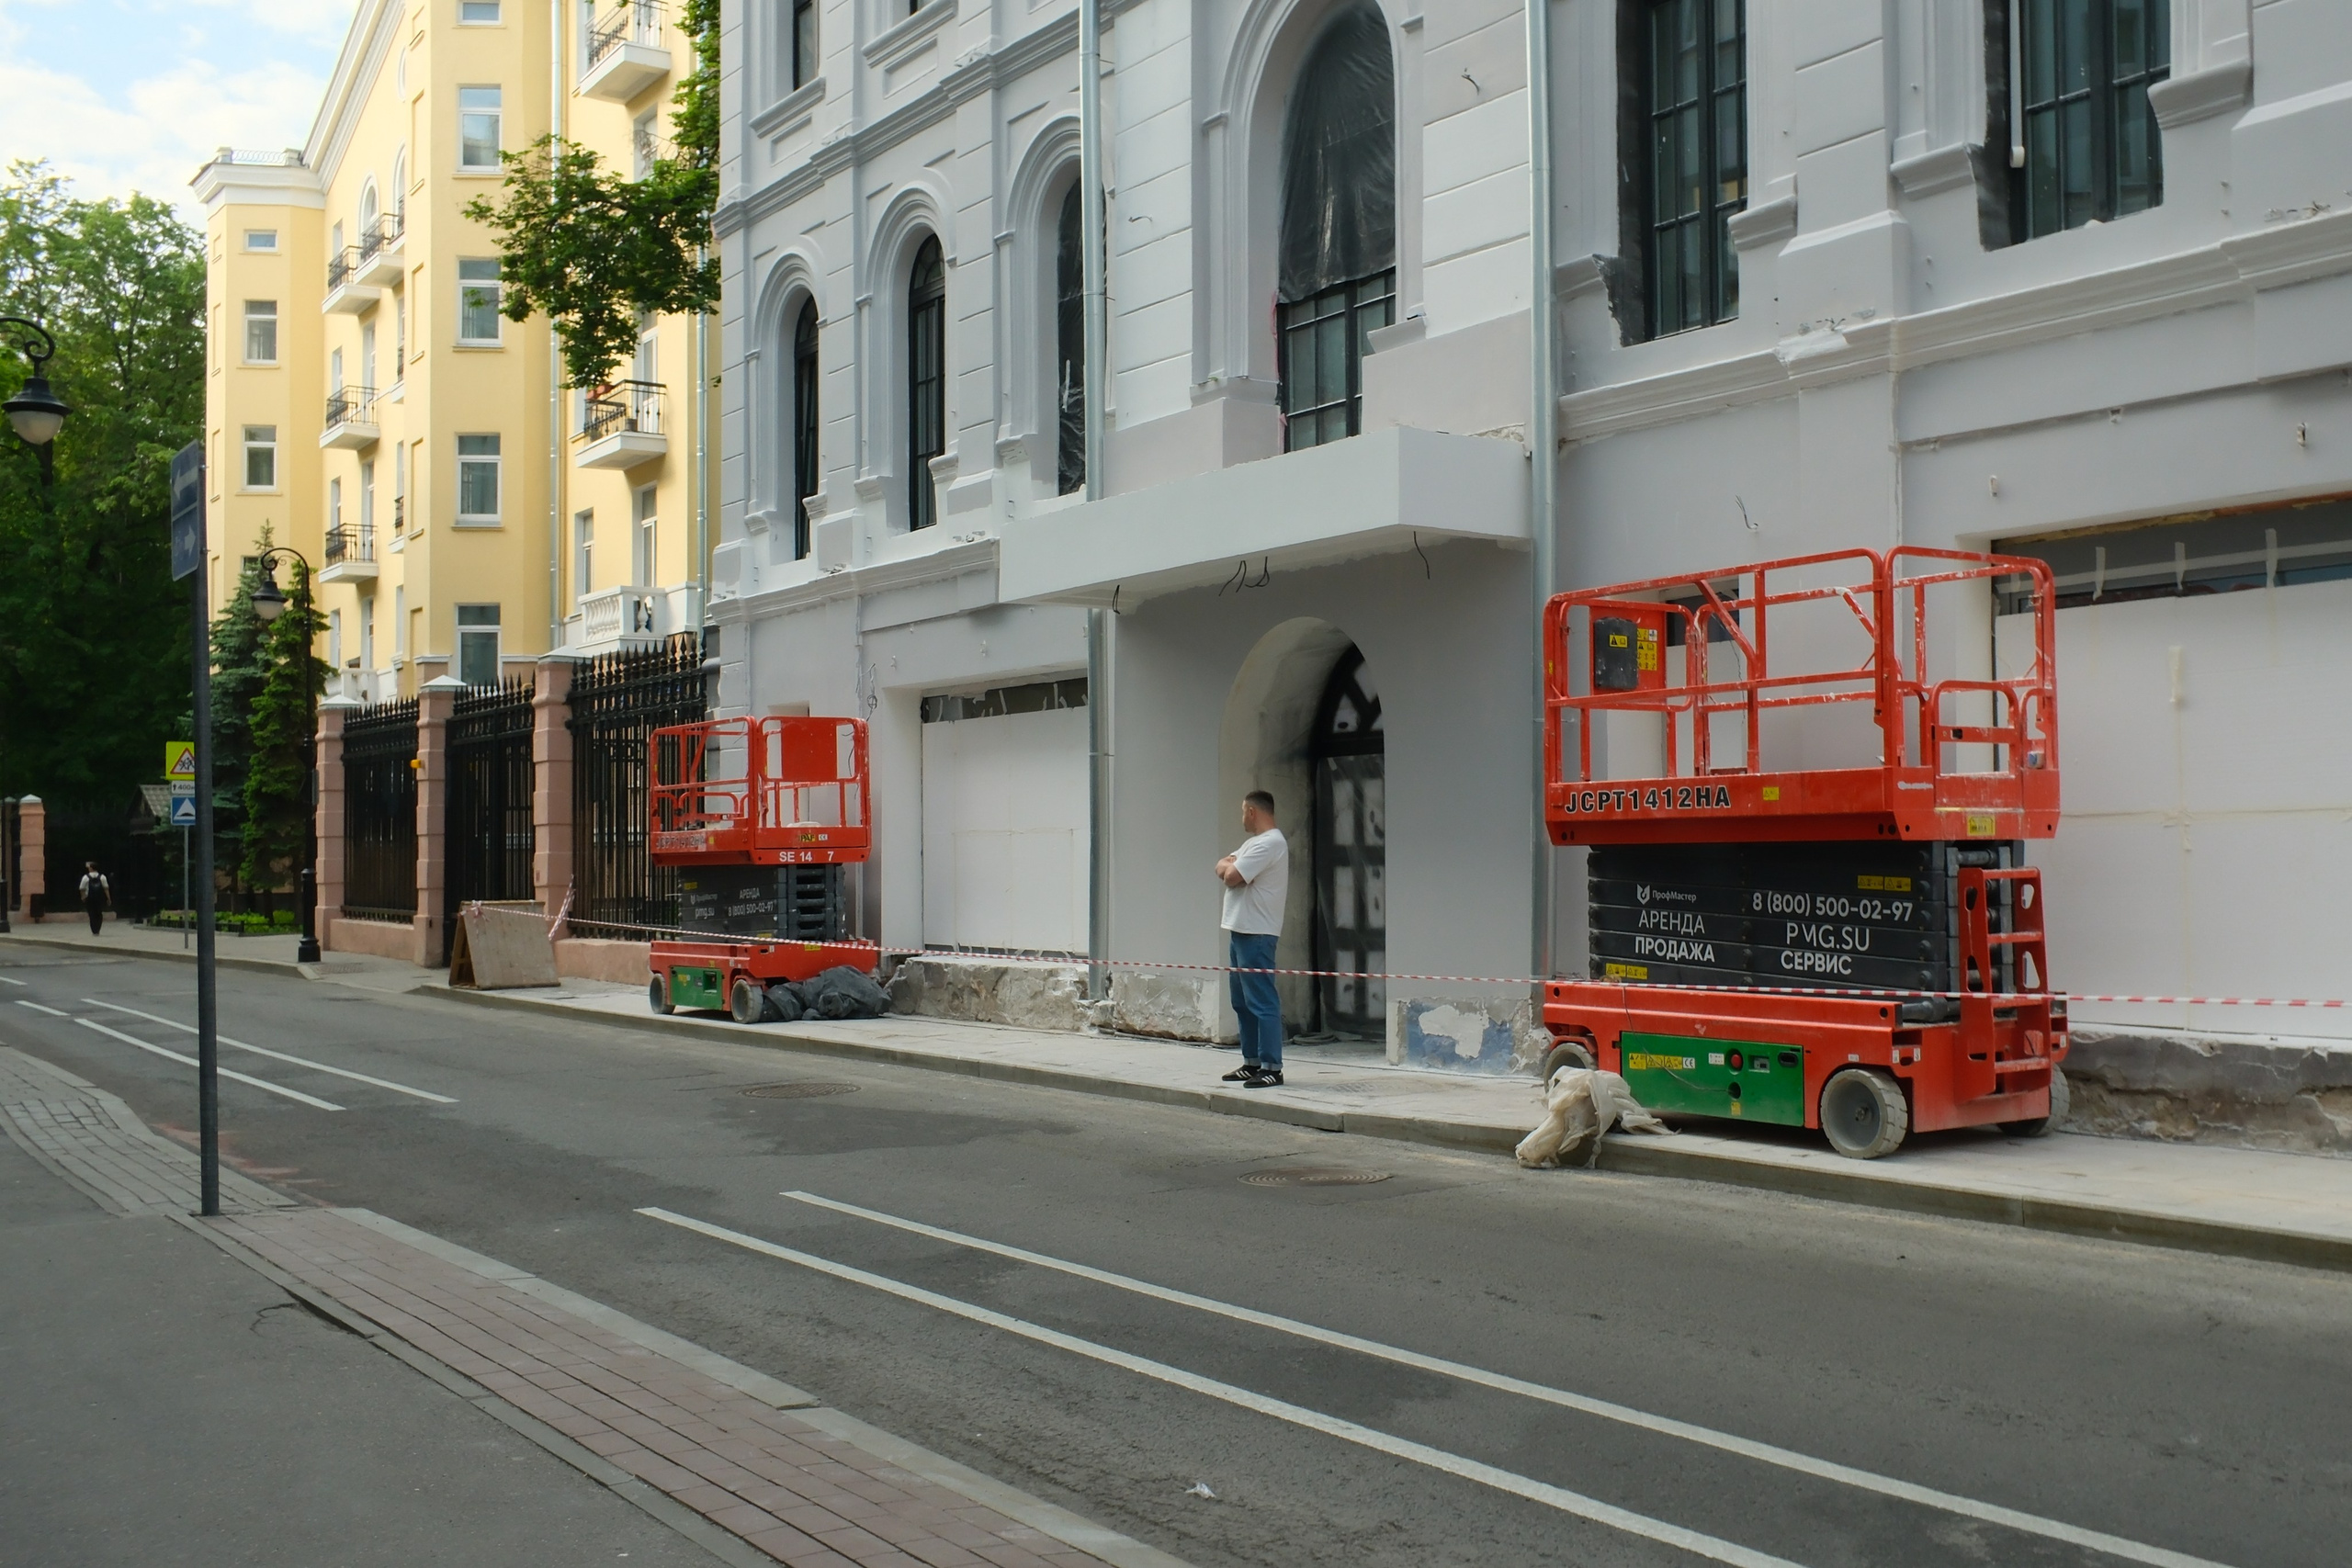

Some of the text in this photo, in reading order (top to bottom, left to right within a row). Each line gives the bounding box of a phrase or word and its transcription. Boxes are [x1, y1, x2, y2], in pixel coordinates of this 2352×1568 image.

[1566, 785, 1731, 813] JCPT1412HA
[779, 851, 834, 863] SE 14 7
[740, 887, 761, 899] АРЕНДА
[1652, 890, 1697, 904] ПрофМастер
[1752, 891, 1913, 921] 8 (800) 500-02-97
[1638, 909, 1705, 936] АРЕНДА
[1635, 936, 1715, 963] ПРОДАЖА
[1786, 922, 1870, 952] PMG.SU
[1781, 950, 1852, 975] СЕРВИС
